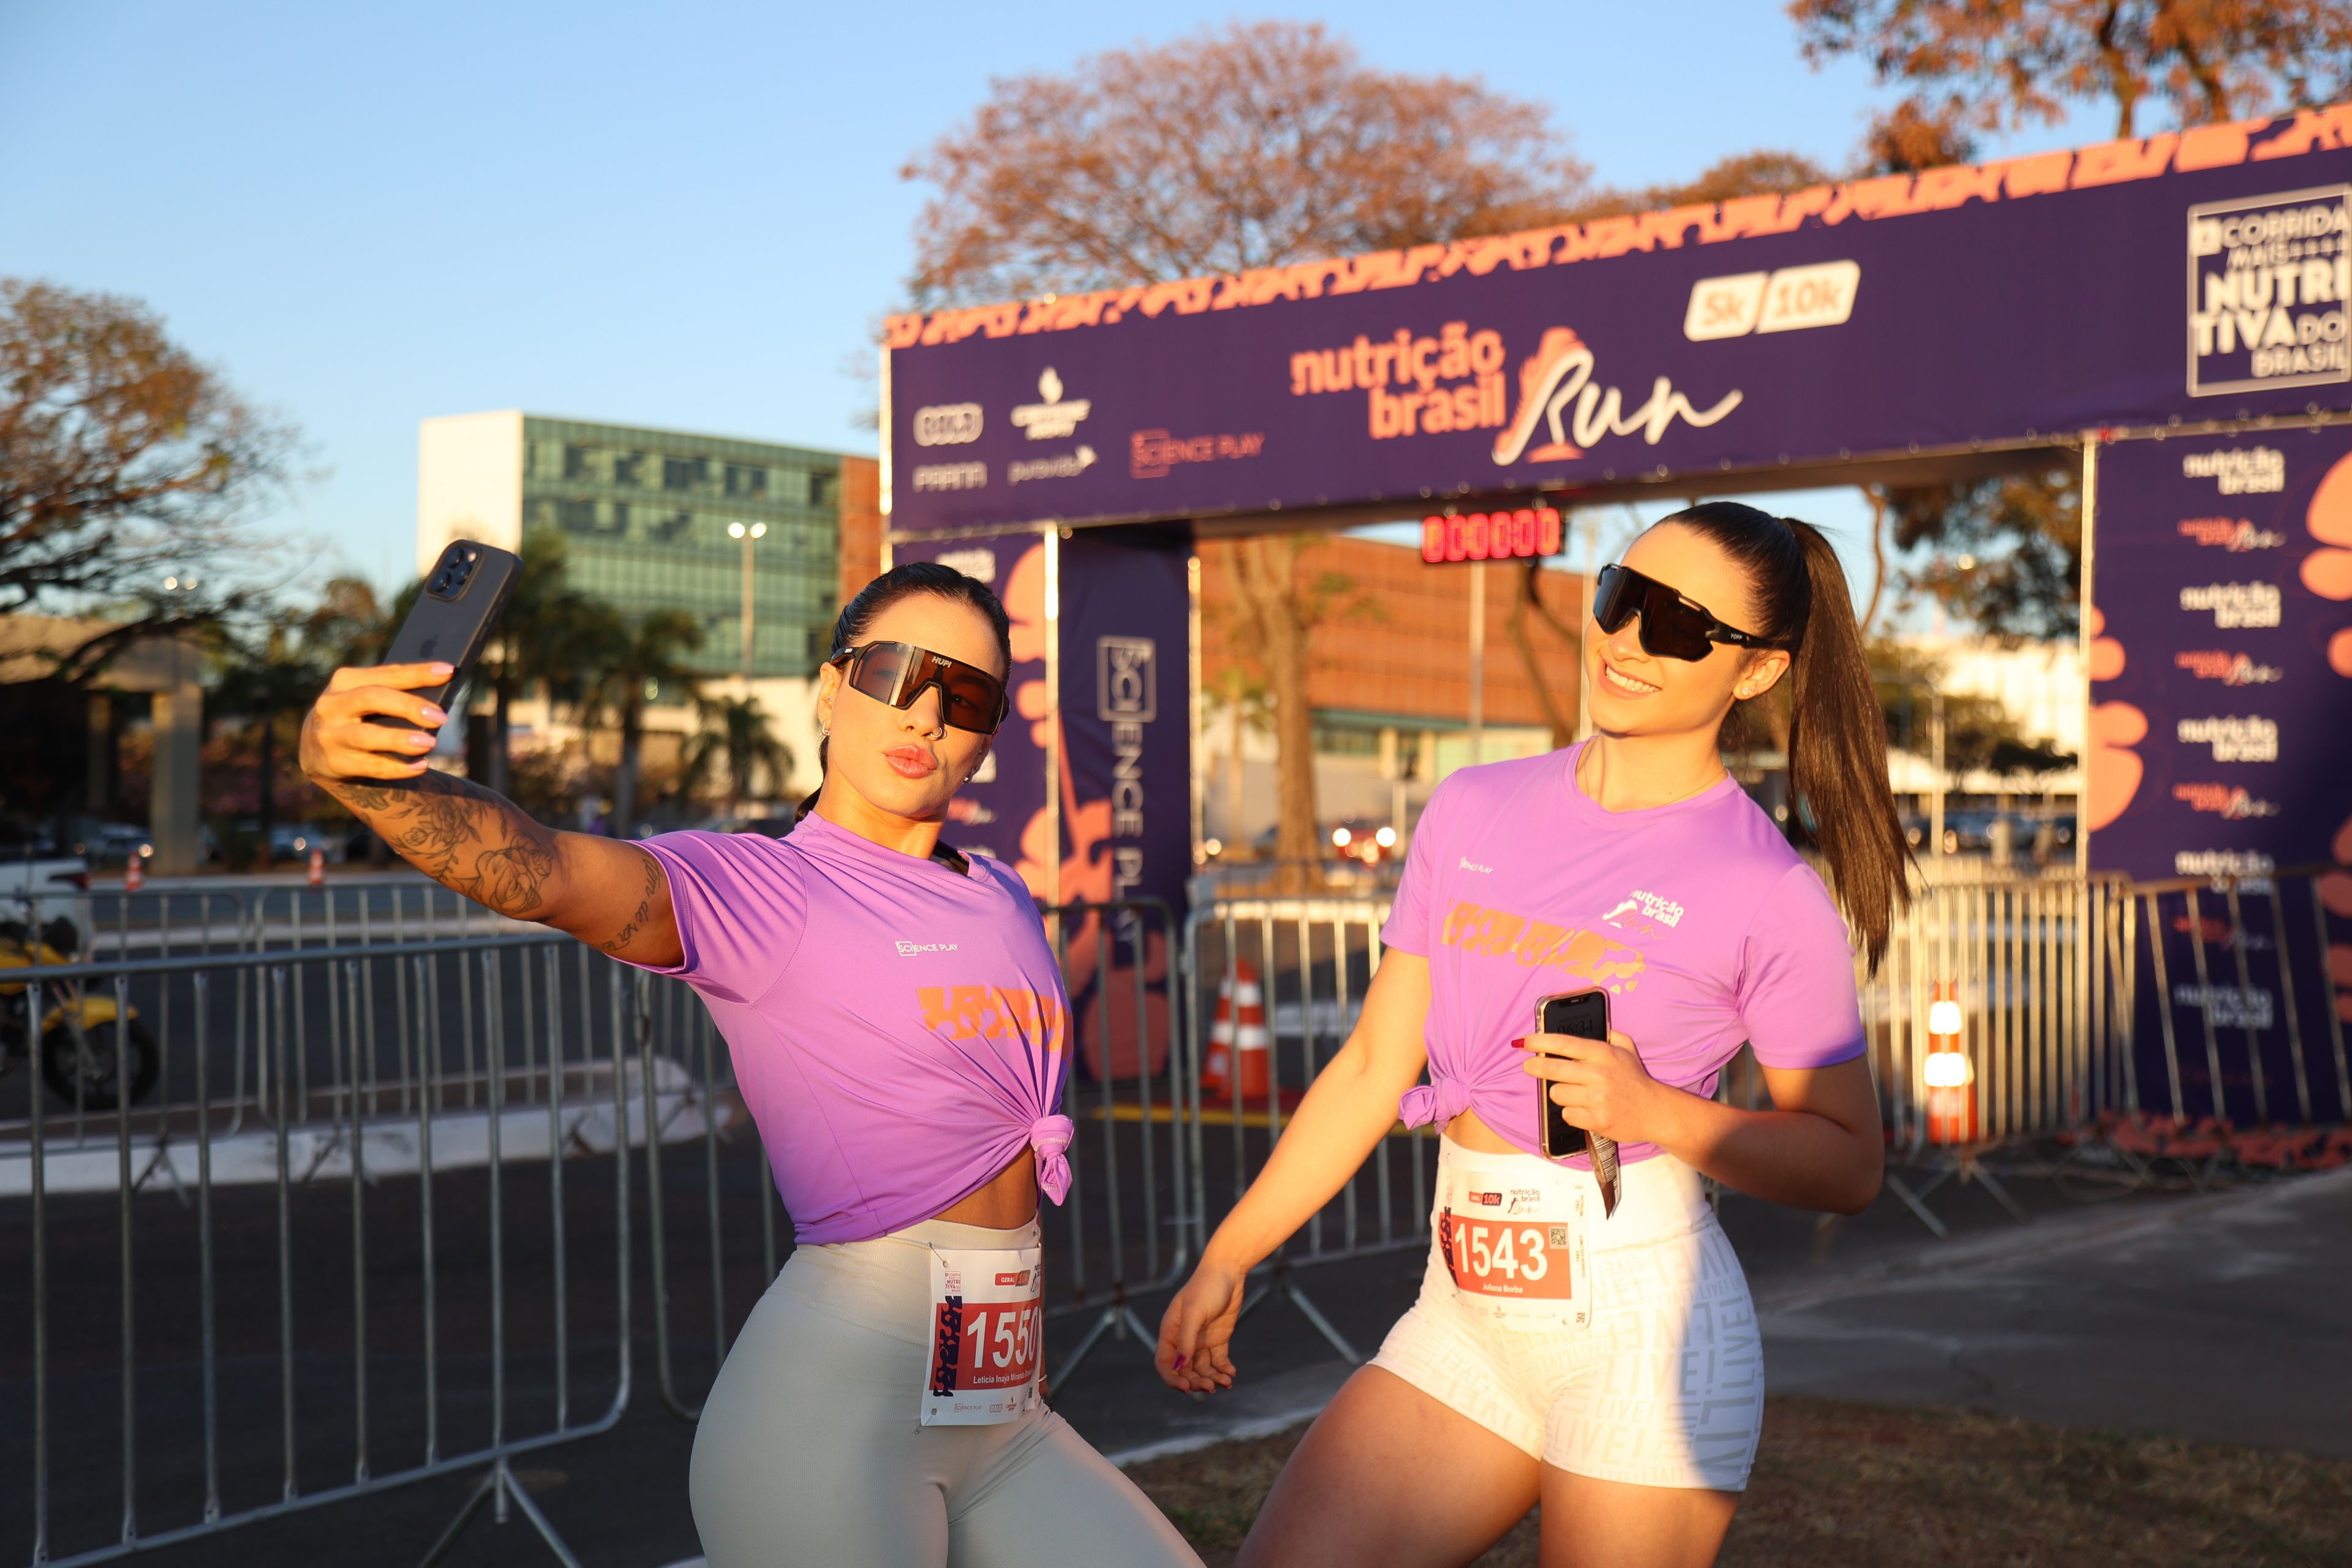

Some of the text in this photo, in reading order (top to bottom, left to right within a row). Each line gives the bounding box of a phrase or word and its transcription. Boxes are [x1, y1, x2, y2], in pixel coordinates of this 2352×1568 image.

[1702, 276, 1843, 327] 5k 10k
[2205, 254, 2351, 316] NUTRI
[2189, 304, 2297, 356] TIVA
[2296, 311, 2346, 345] DO
[1289, 320, 1506, 396] nutrição
[2251, 341, 2348, 378] BRASIL
[1368, 371, 1506, 440] brasil
[1491, 346, 1744, 466] Run
[931, 656, 952, 668] HUPI
[1111, 645, 1144, 838] SCIENCE
[1629, 890, 1684, 918] nutrição
[1642, 905, 1681, 928] brasil
[1483, 1194, 1500, 1205] 10k
[1455, 1223, 1548, 1281] 1543
[1503, 1284, 1523, 1294] Borba
[967, 1306, 1039, 1369] 1550
[973, 1376, 995, 1384] Leticia
[995, 1375, 1010, 1384] Inaya
[1594, 1397, 1656, 1423] LIVE!
